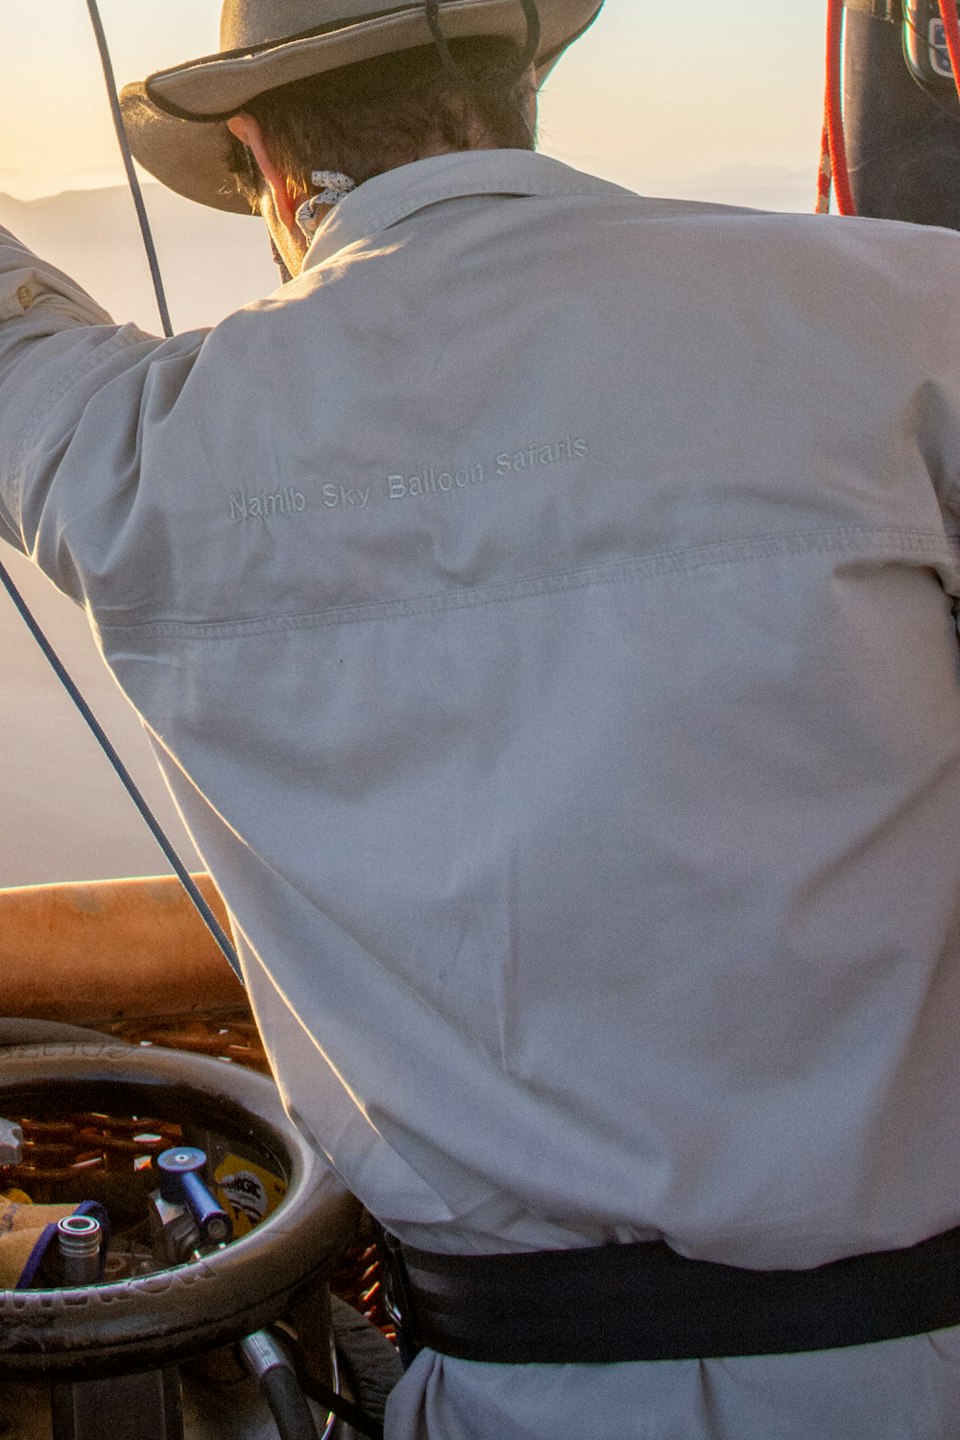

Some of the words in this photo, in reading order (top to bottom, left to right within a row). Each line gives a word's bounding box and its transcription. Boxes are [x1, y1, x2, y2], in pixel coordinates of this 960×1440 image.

[228, 487, 307, 521] Namib
[322, 483, 372, 508] Sky
[388, 463, 484, 500] Balloon
[497, 435, 590, 476] Safaris
